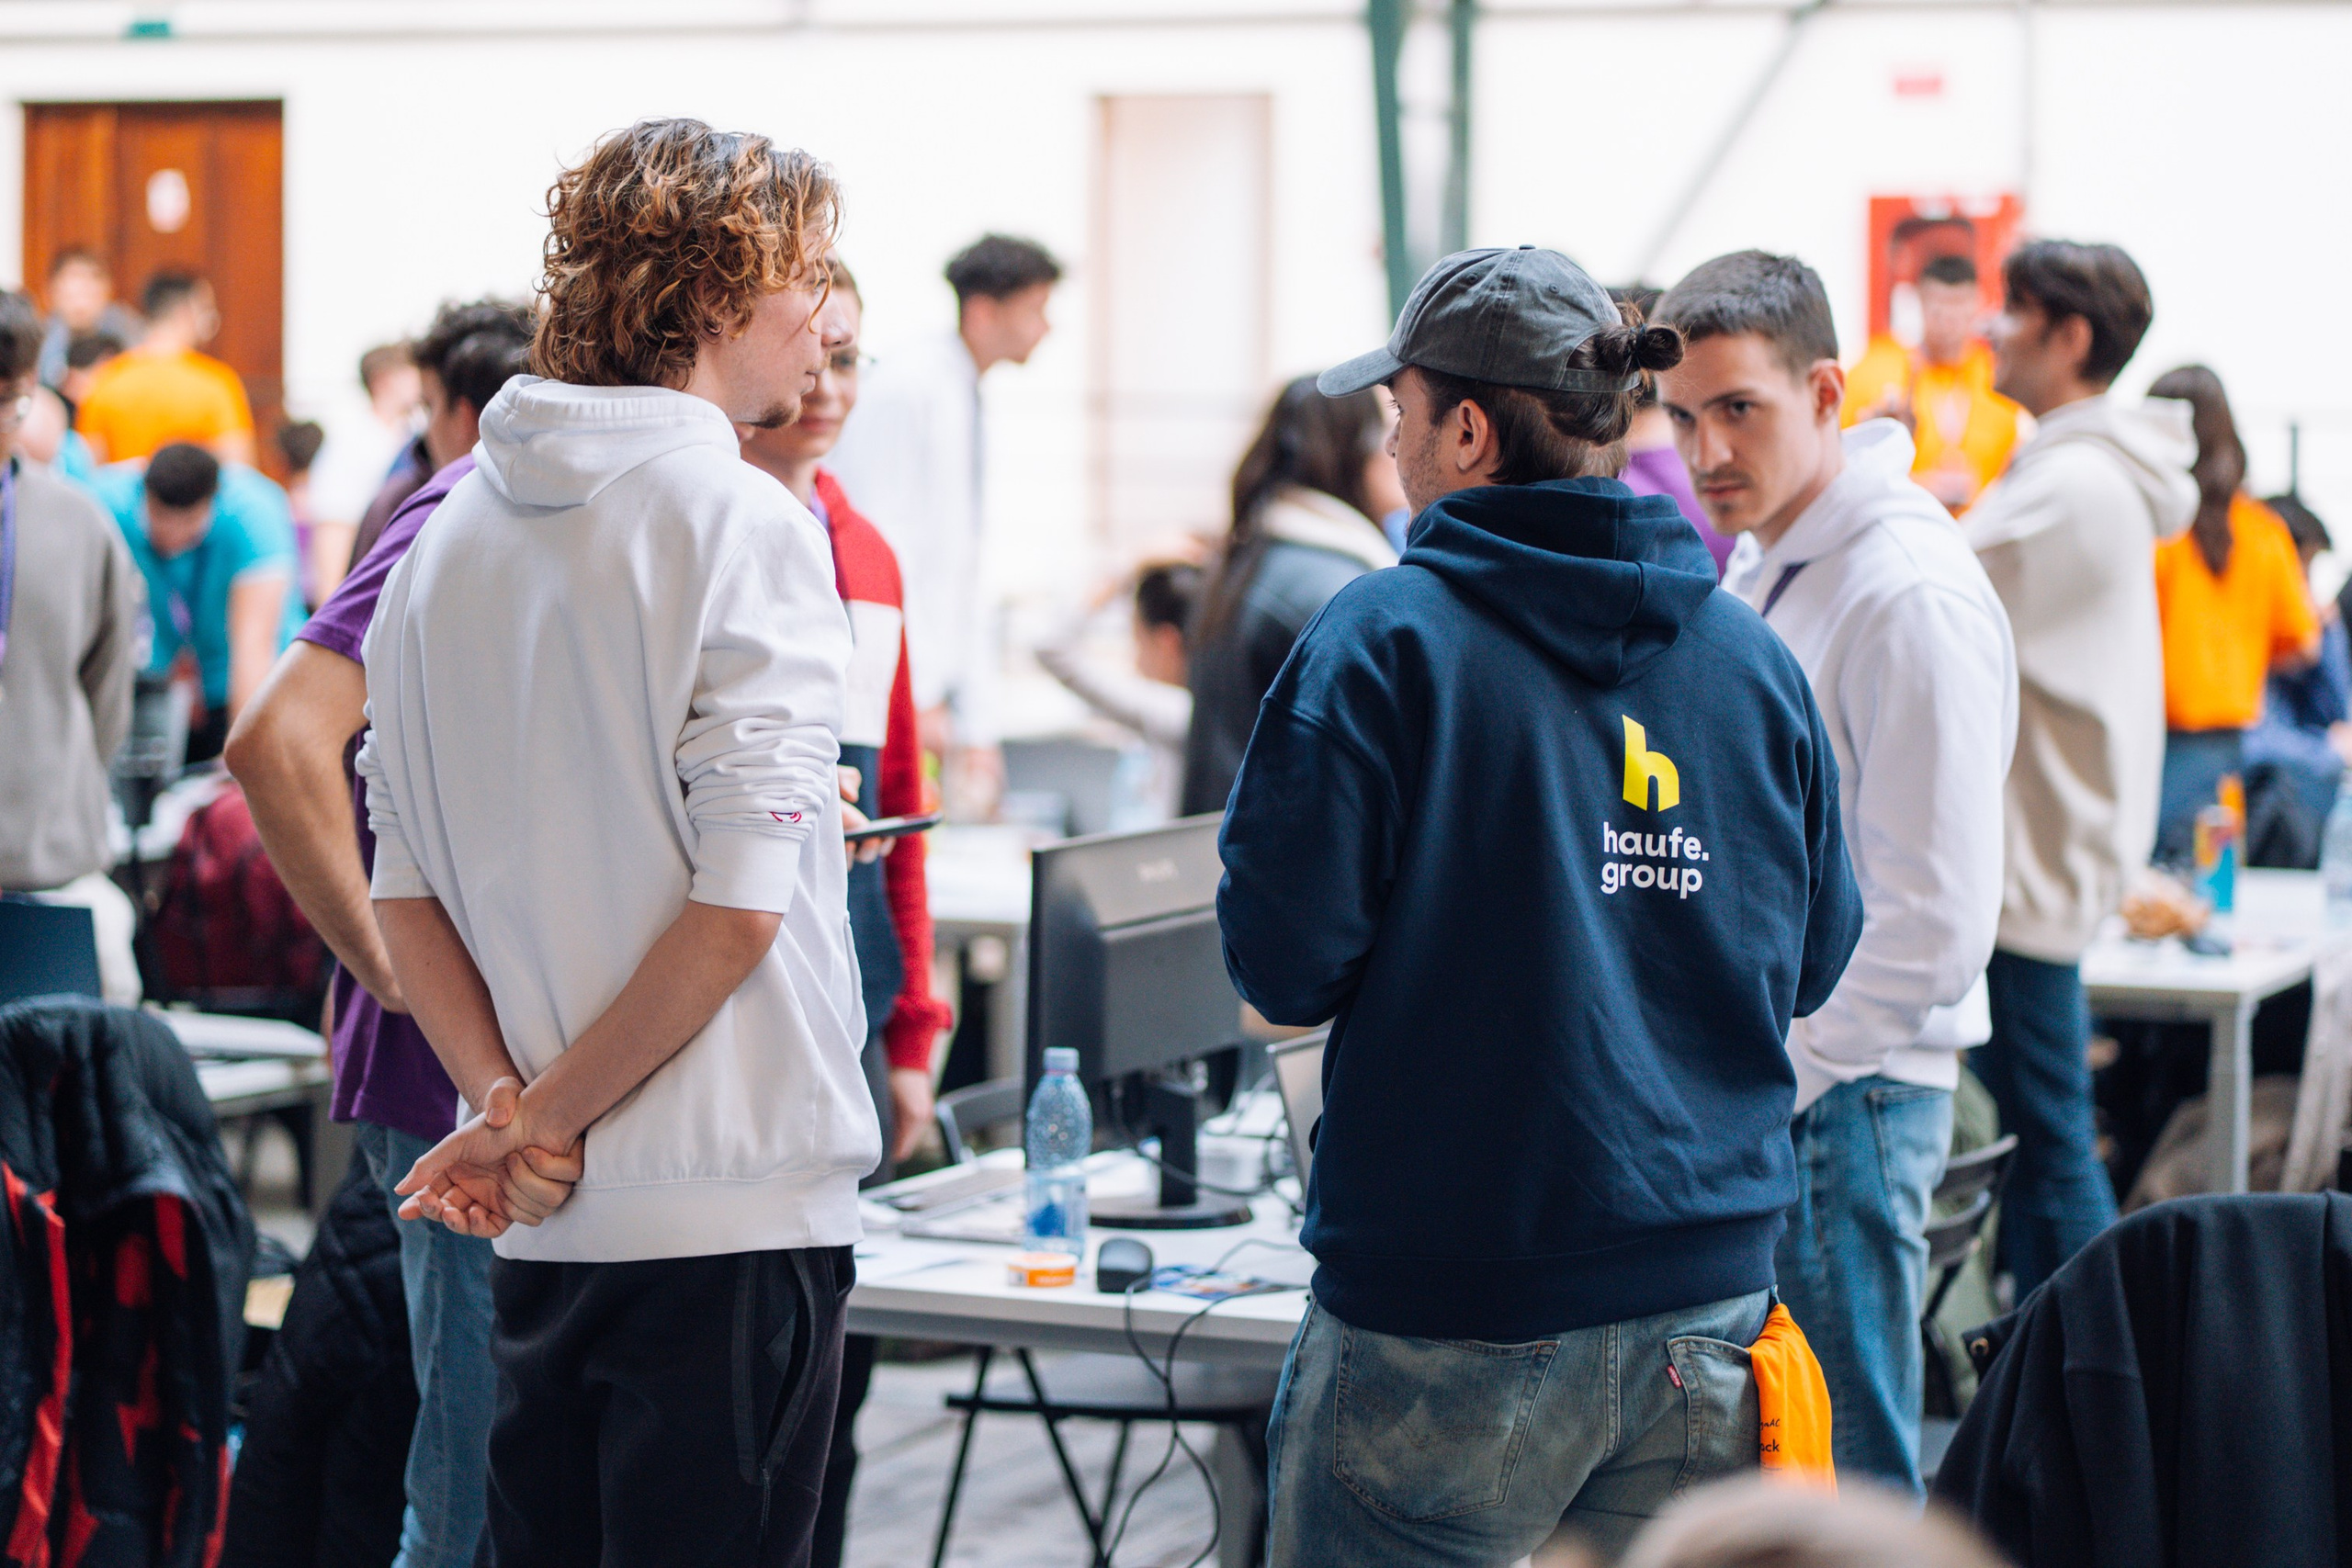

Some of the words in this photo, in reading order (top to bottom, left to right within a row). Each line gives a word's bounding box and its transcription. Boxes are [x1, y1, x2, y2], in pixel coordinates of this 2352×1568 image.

[1622, 714, 1679, 812] h
[1603, 821, 1710, 861] haufe.
[1600, 862, 1702, 899] group
